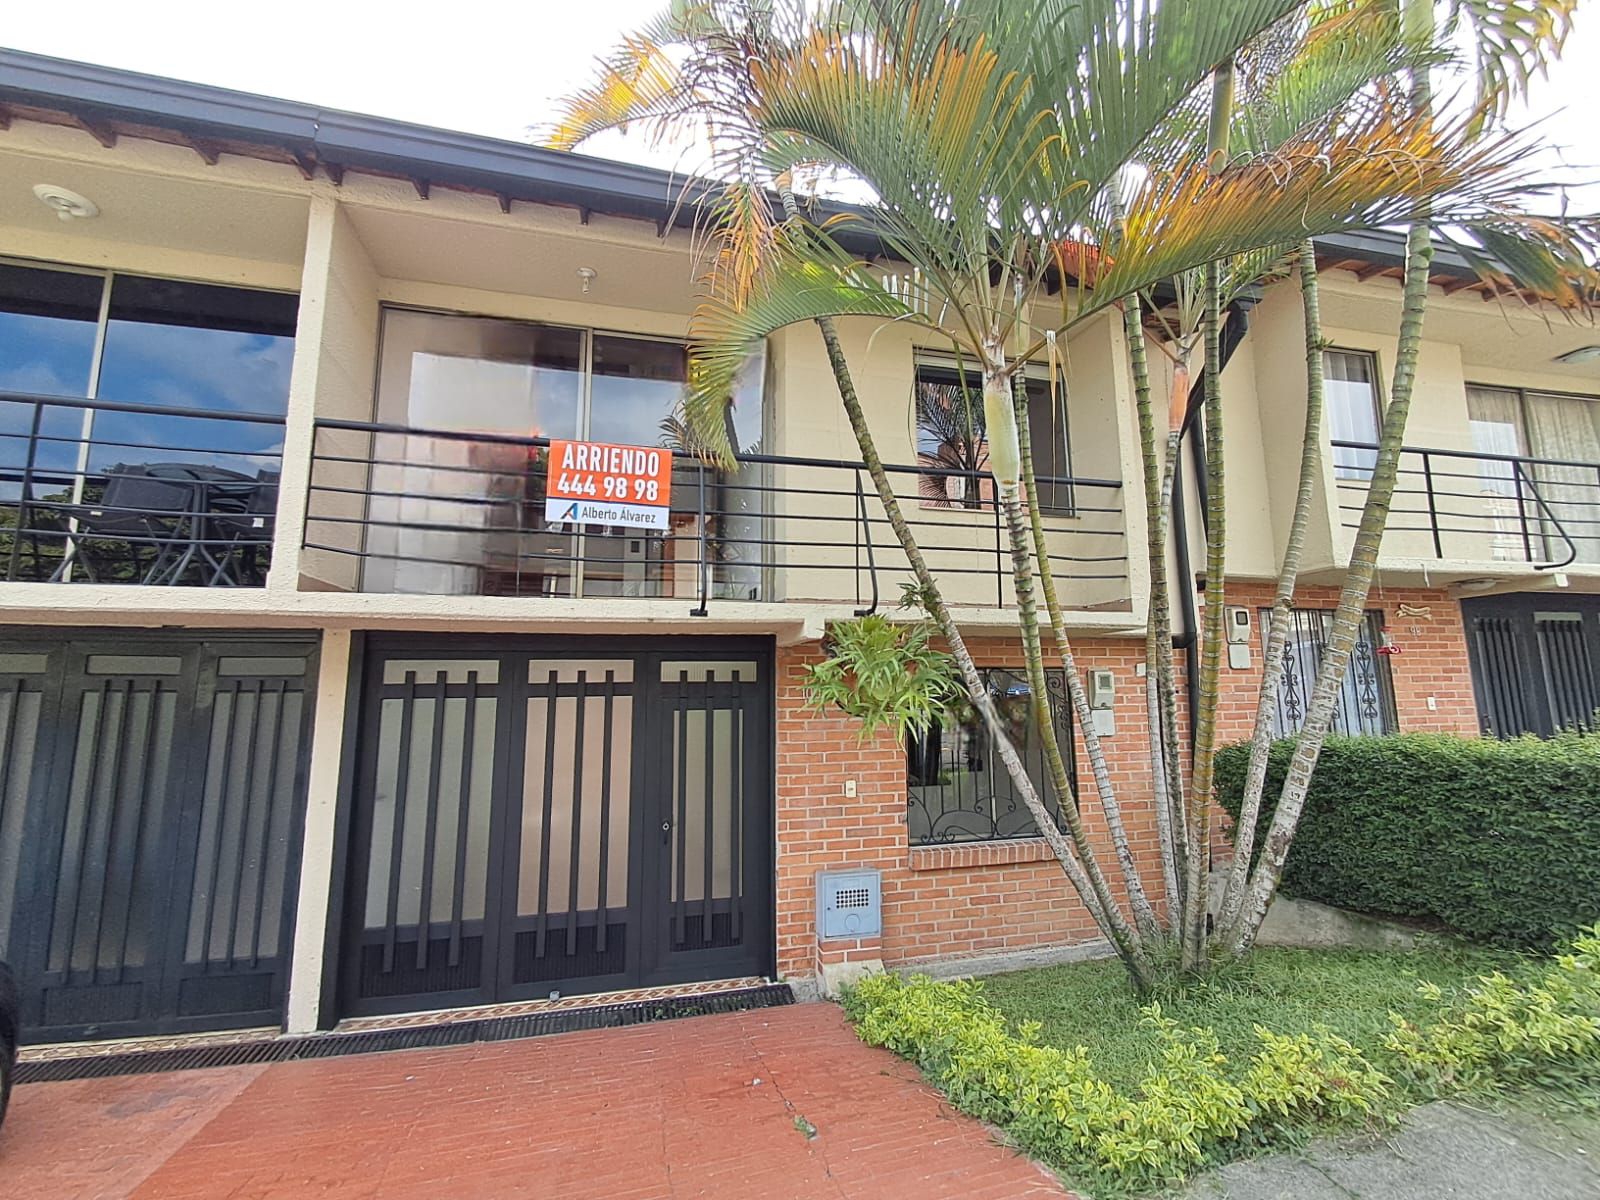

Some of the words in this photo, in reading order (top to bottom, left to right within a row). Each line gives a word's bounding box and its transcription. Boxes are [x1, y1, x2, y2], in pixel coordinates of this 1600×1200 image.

[561, 443, 659, 477] ARRIENDO
[557, 472, 596, 496] 444
[603, 476, 628, 499] 98
[634, 479, 659, 501] 98
[581, 506, 617, 521] Alberto
[620, 506, 656, 524] Álvarez
